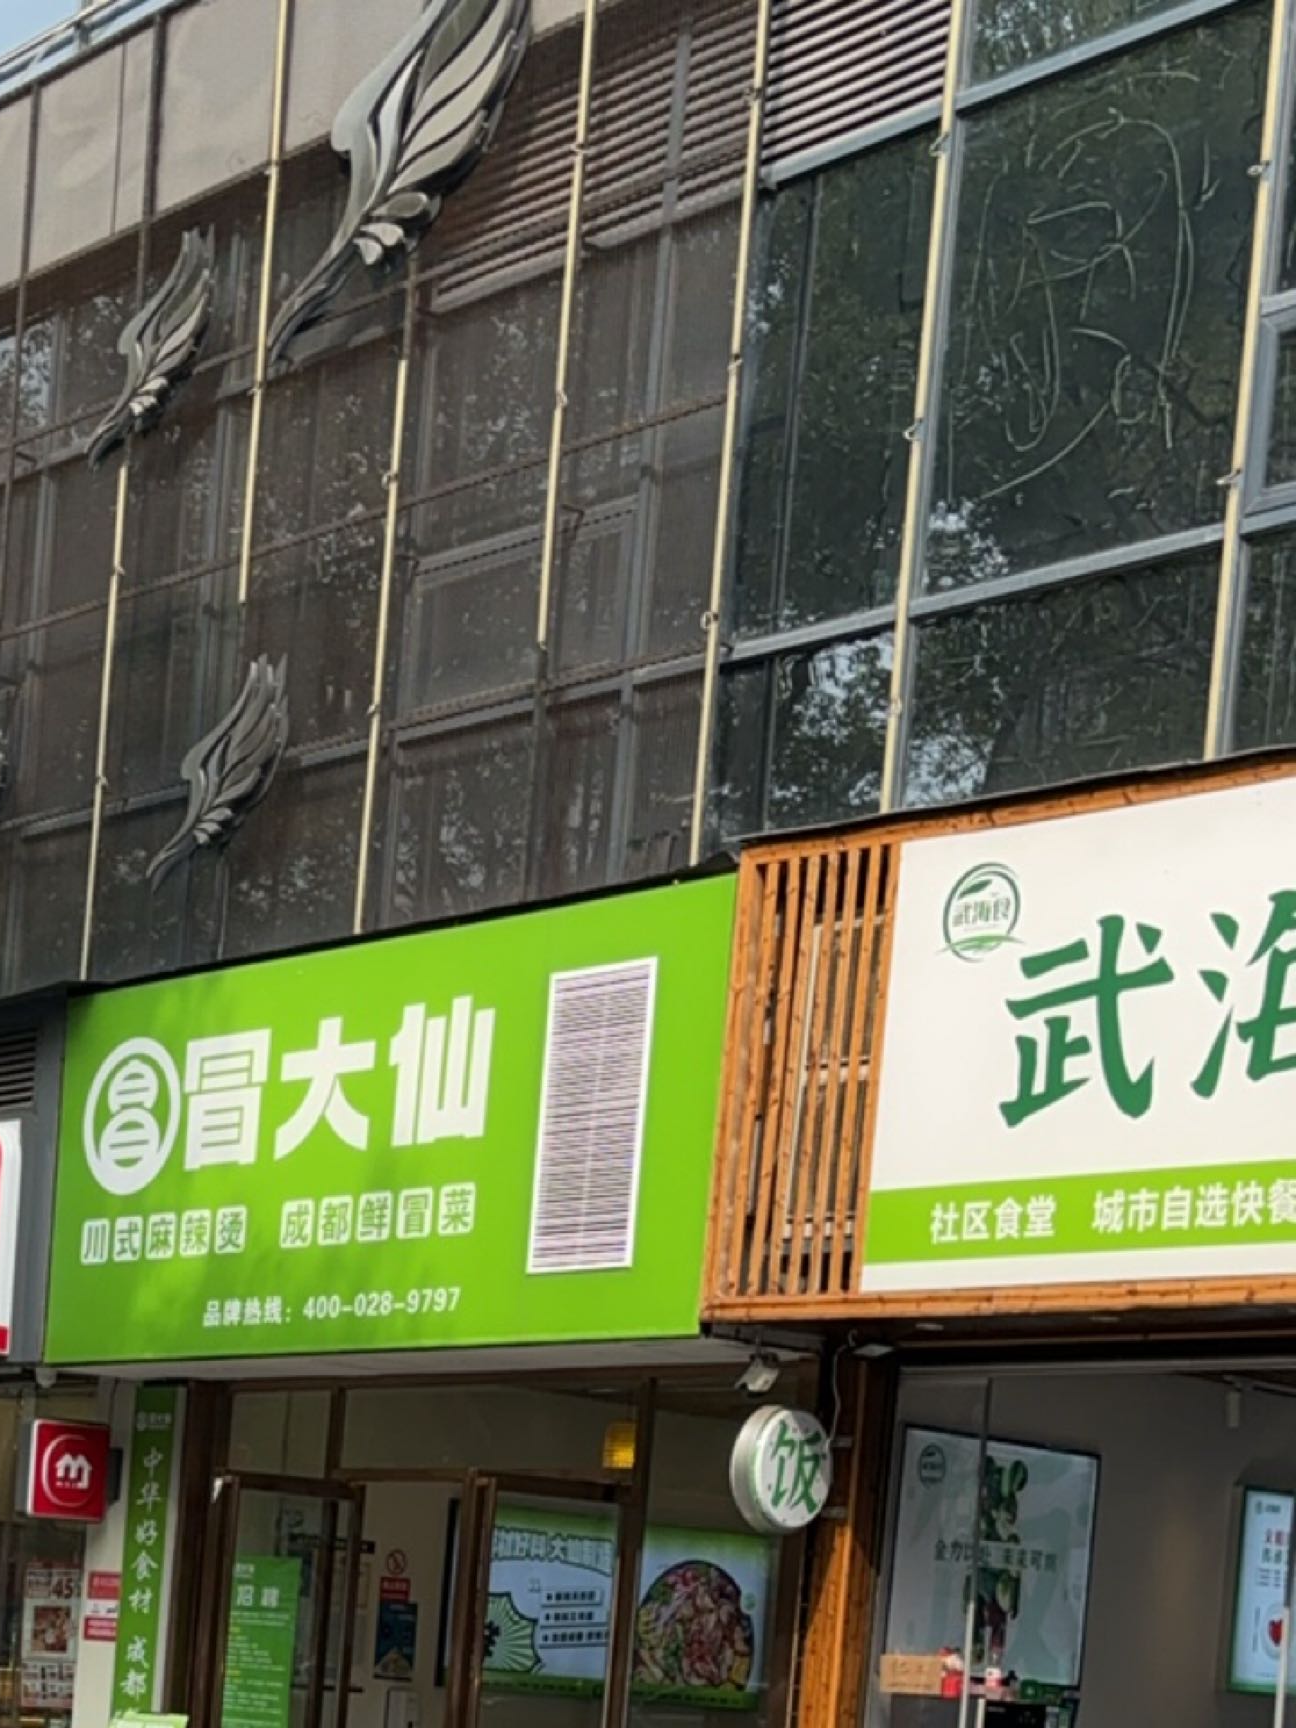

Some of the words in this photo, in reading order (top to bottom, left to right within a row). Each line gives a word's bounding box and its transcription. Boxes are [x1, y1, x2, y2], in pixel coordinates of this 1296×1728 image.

[82, 1208, 246, 1264] 川式麻辣烫
[282, 1184, 475, 1247] 成都鲜冒菜
[930, 1195, 1057, 1244] 社区食堂
[1092, 1179, 1296, 1235] 城市自选快餐
[770, 1420, 825, 1513] 饭
[128, 1446, 164, 1614] 中华好食材
[116, 1635, 150, 1713] 成都
